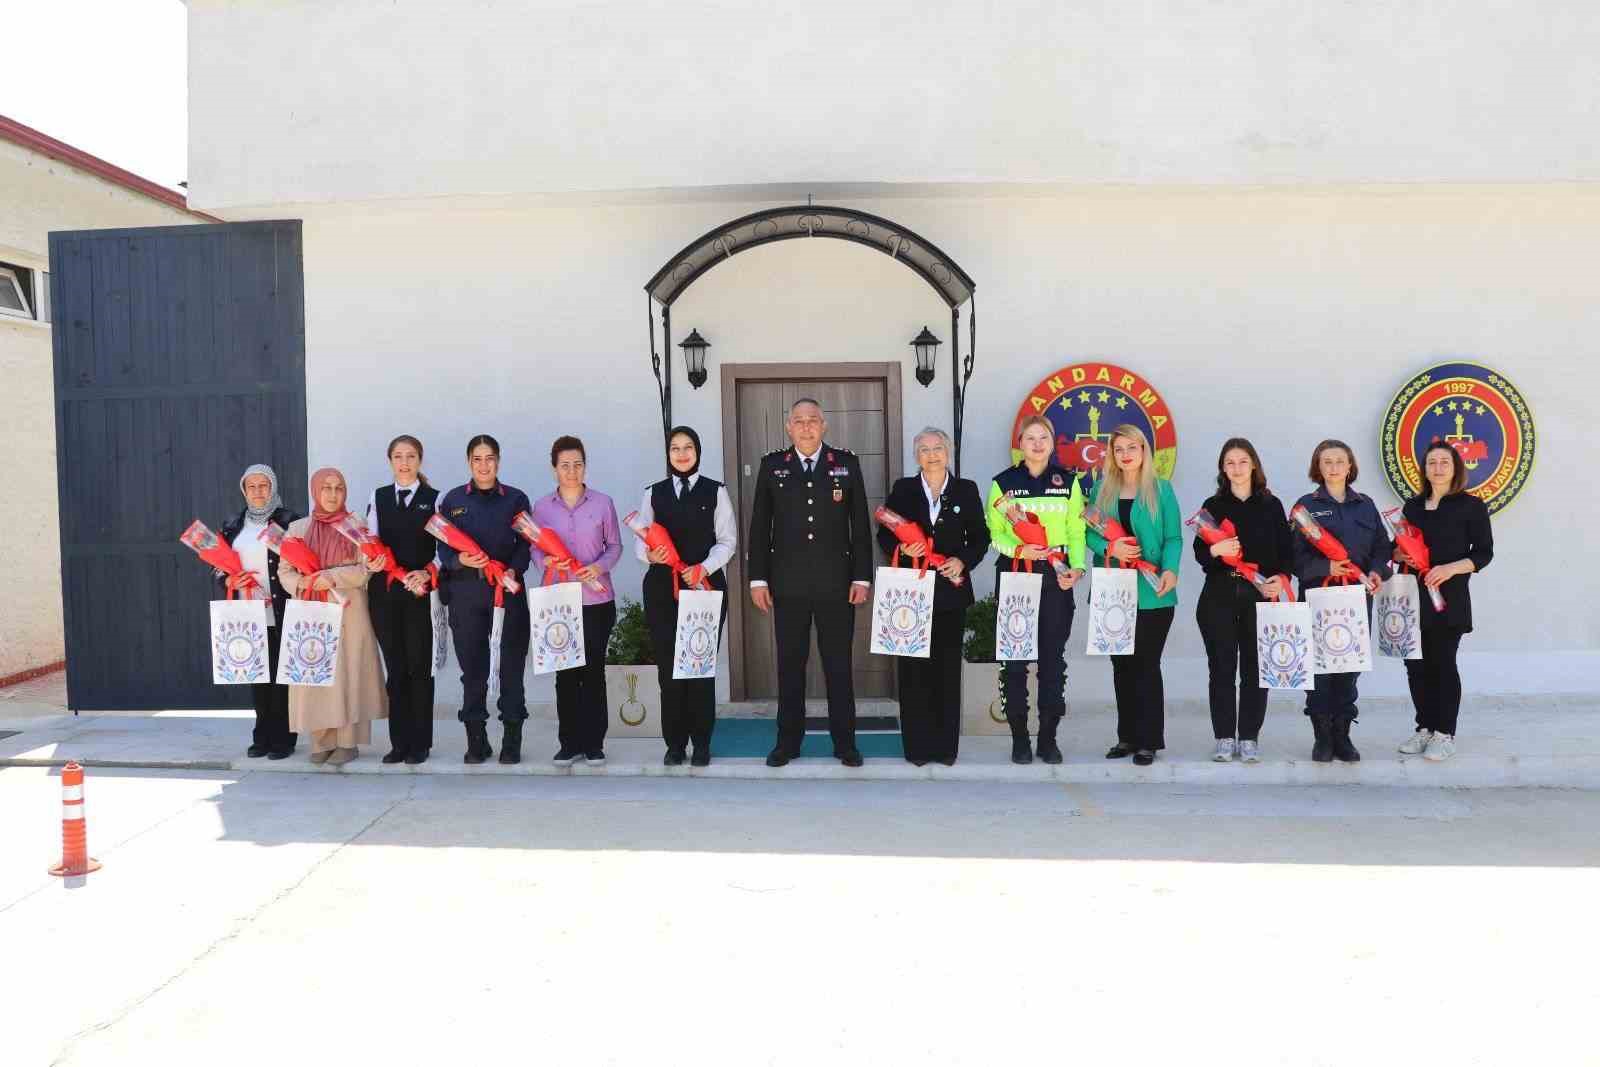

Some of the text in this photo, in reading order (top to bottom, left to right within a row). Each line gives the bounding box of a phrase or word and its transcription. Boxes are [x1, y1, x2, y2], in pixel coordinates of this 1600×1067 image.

[1029, 367, 1168, 429] ANDARMA
[1443, 383, 1475, 393] 1997
[1494, 455, 1514, 487] VAKFI
